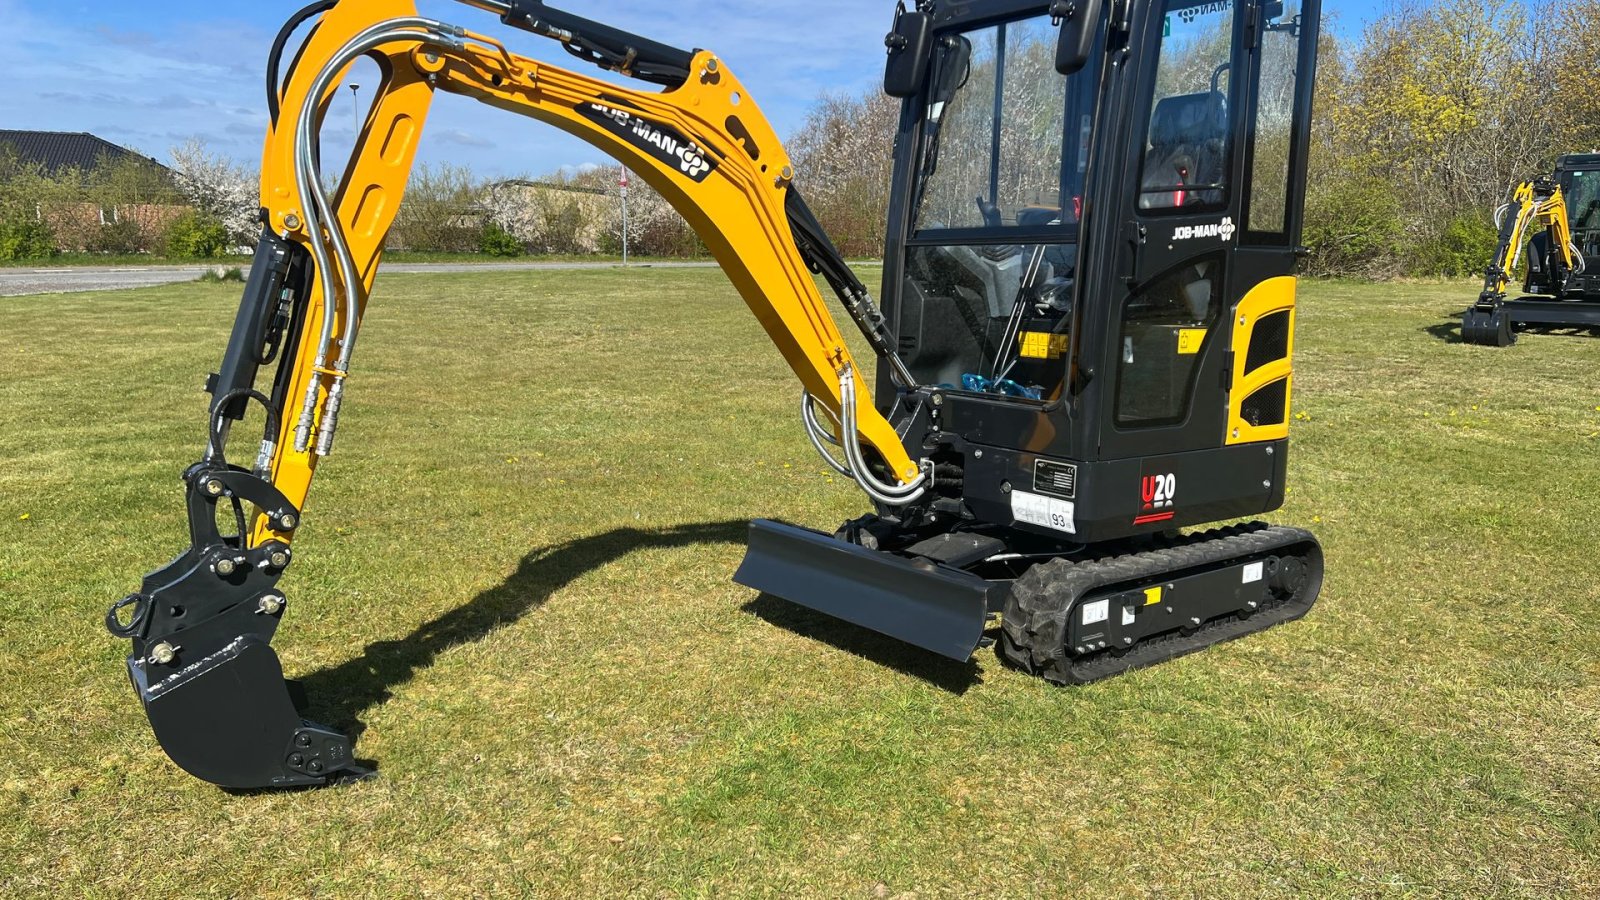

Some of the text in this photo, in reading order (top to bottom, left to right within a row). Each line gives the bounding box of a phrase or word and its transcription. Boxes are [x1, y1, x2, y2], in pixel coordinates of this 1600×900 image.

[1172, 224, 1218, 240] JOB-MAN
[1142, 473, 1176, 503] U20
[1052, 513, 1065, 527] 93
